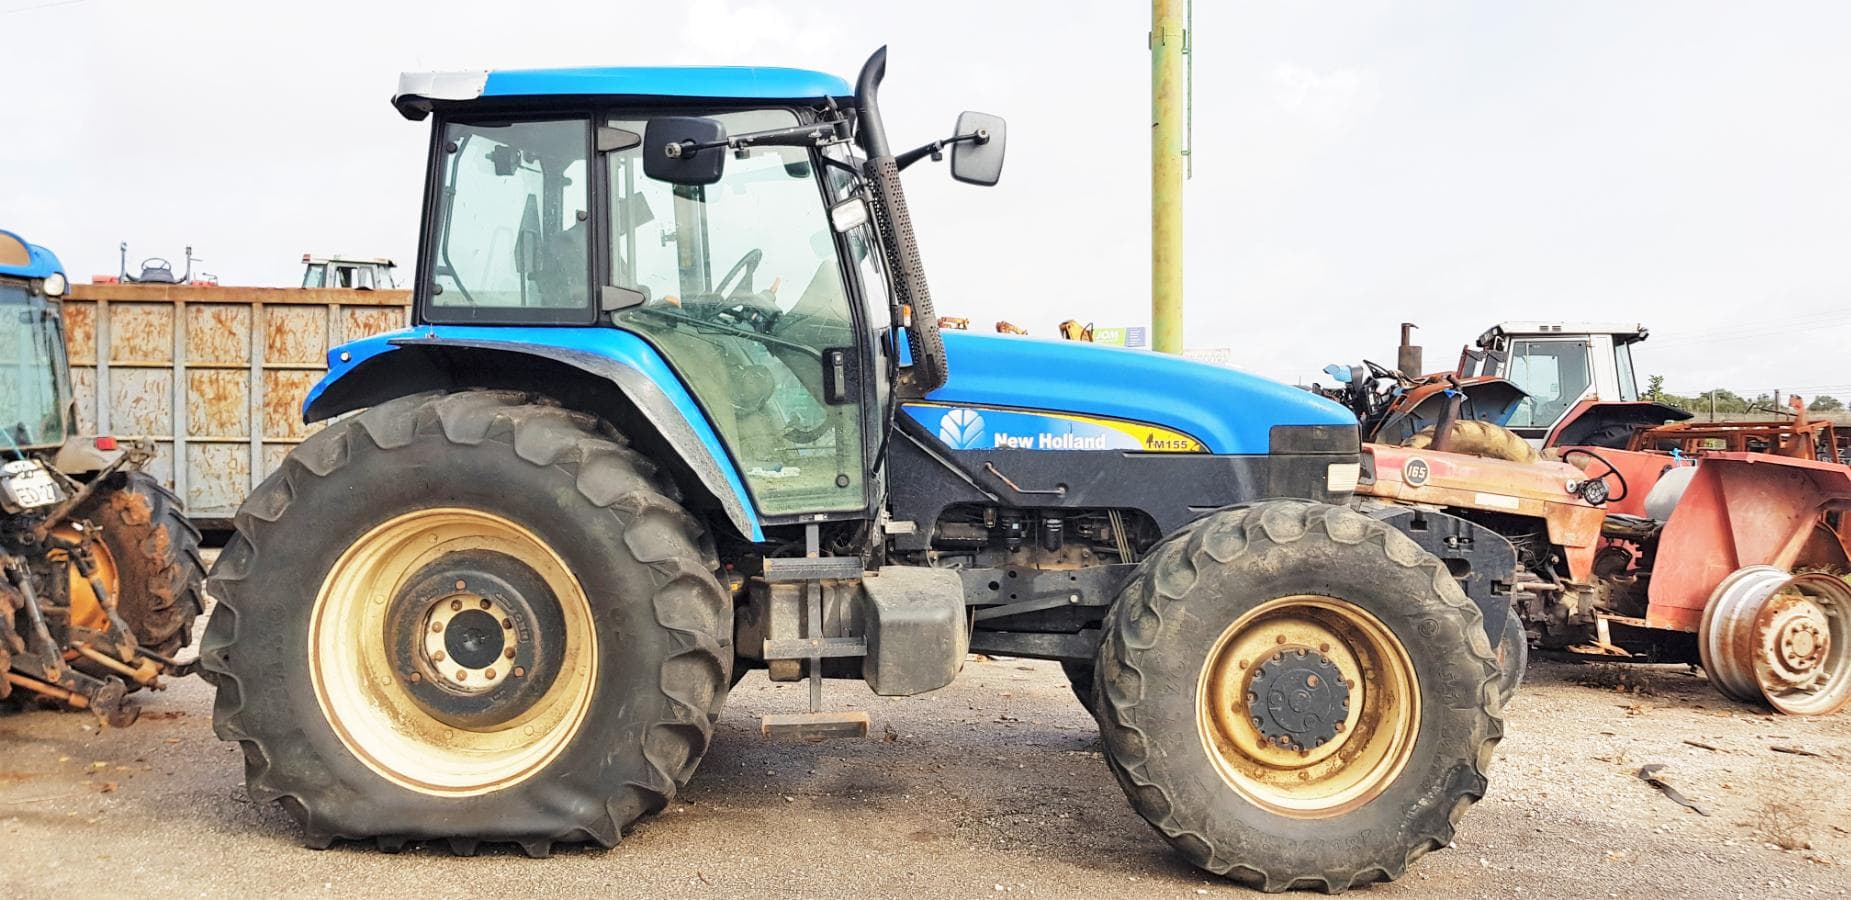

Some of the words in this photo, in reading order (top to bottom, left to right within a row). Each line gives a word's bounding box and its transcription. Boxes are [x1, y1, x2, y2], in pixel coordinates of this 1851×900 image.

[994, 432, 1034, 449] New
[1038, 431, 1106, 450] Holland
[1408, 466, 1428, 479] 165
